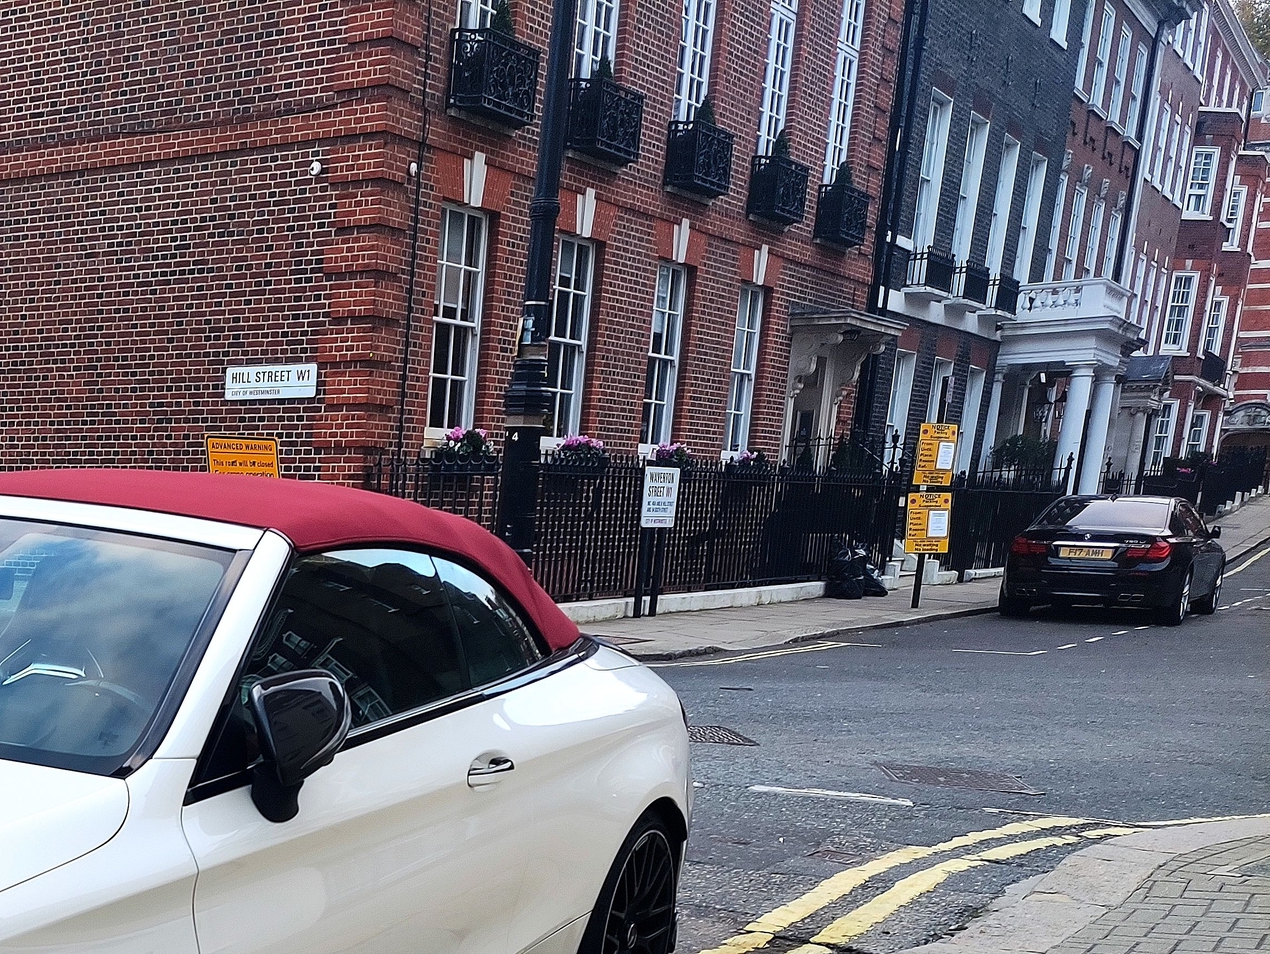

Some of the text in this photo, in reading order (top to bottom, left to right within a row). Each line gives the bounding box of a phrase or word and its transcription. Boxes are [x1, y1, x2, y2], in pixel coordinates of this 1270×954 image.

[231, 369, 311, 384] HILL STREET W1
[211, 442, 272, 452] ADVANCED WARNING
[650, 472, 674, 483] WAVERTON
[648, 486, 665, 497] STREET
